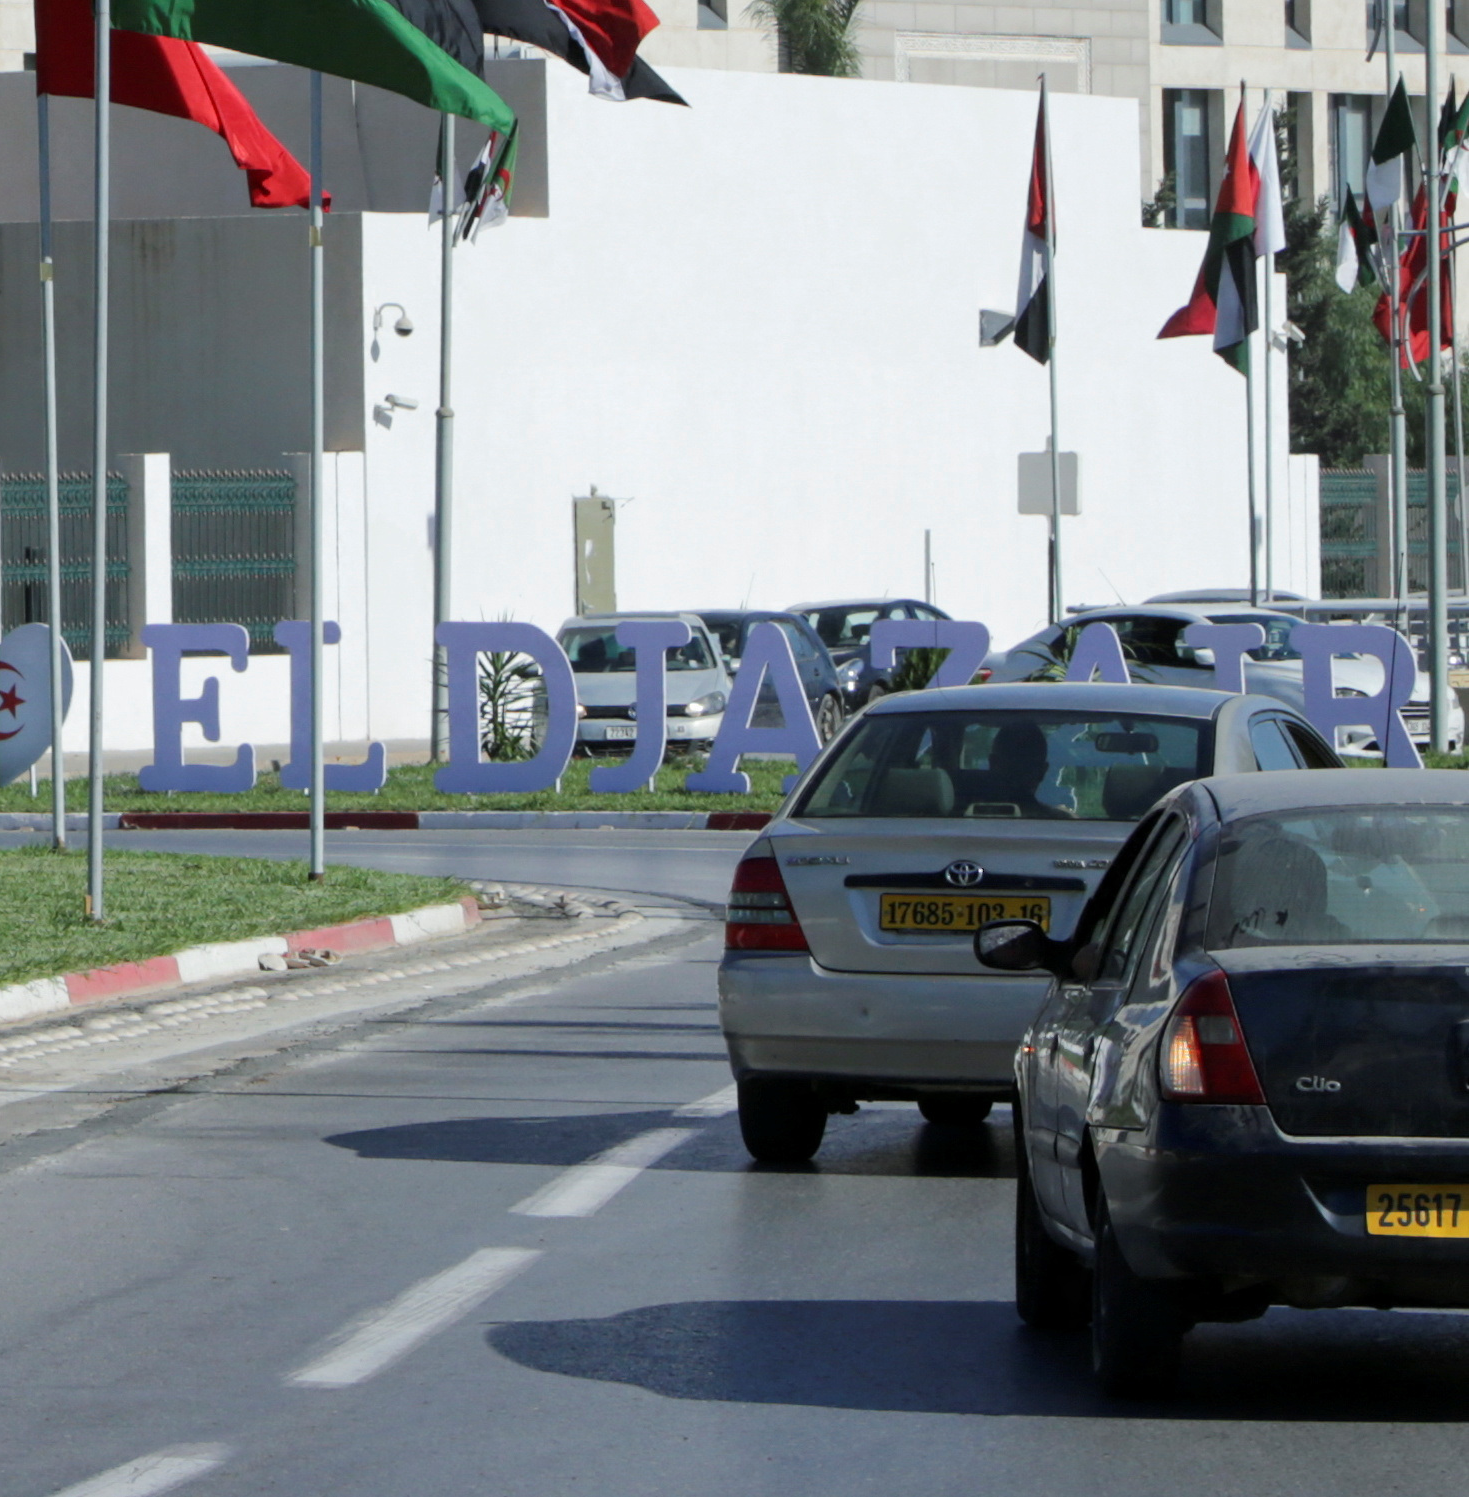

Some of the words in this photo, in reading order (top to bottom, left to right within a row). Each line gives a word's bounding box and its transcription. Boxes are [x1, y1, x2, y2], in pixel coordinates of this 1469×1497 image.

[139, 620, 387, 793] EL
[1296, 1075, 1341, 1092] Clio
[1378, 1193, 1462, 1228] 25617
